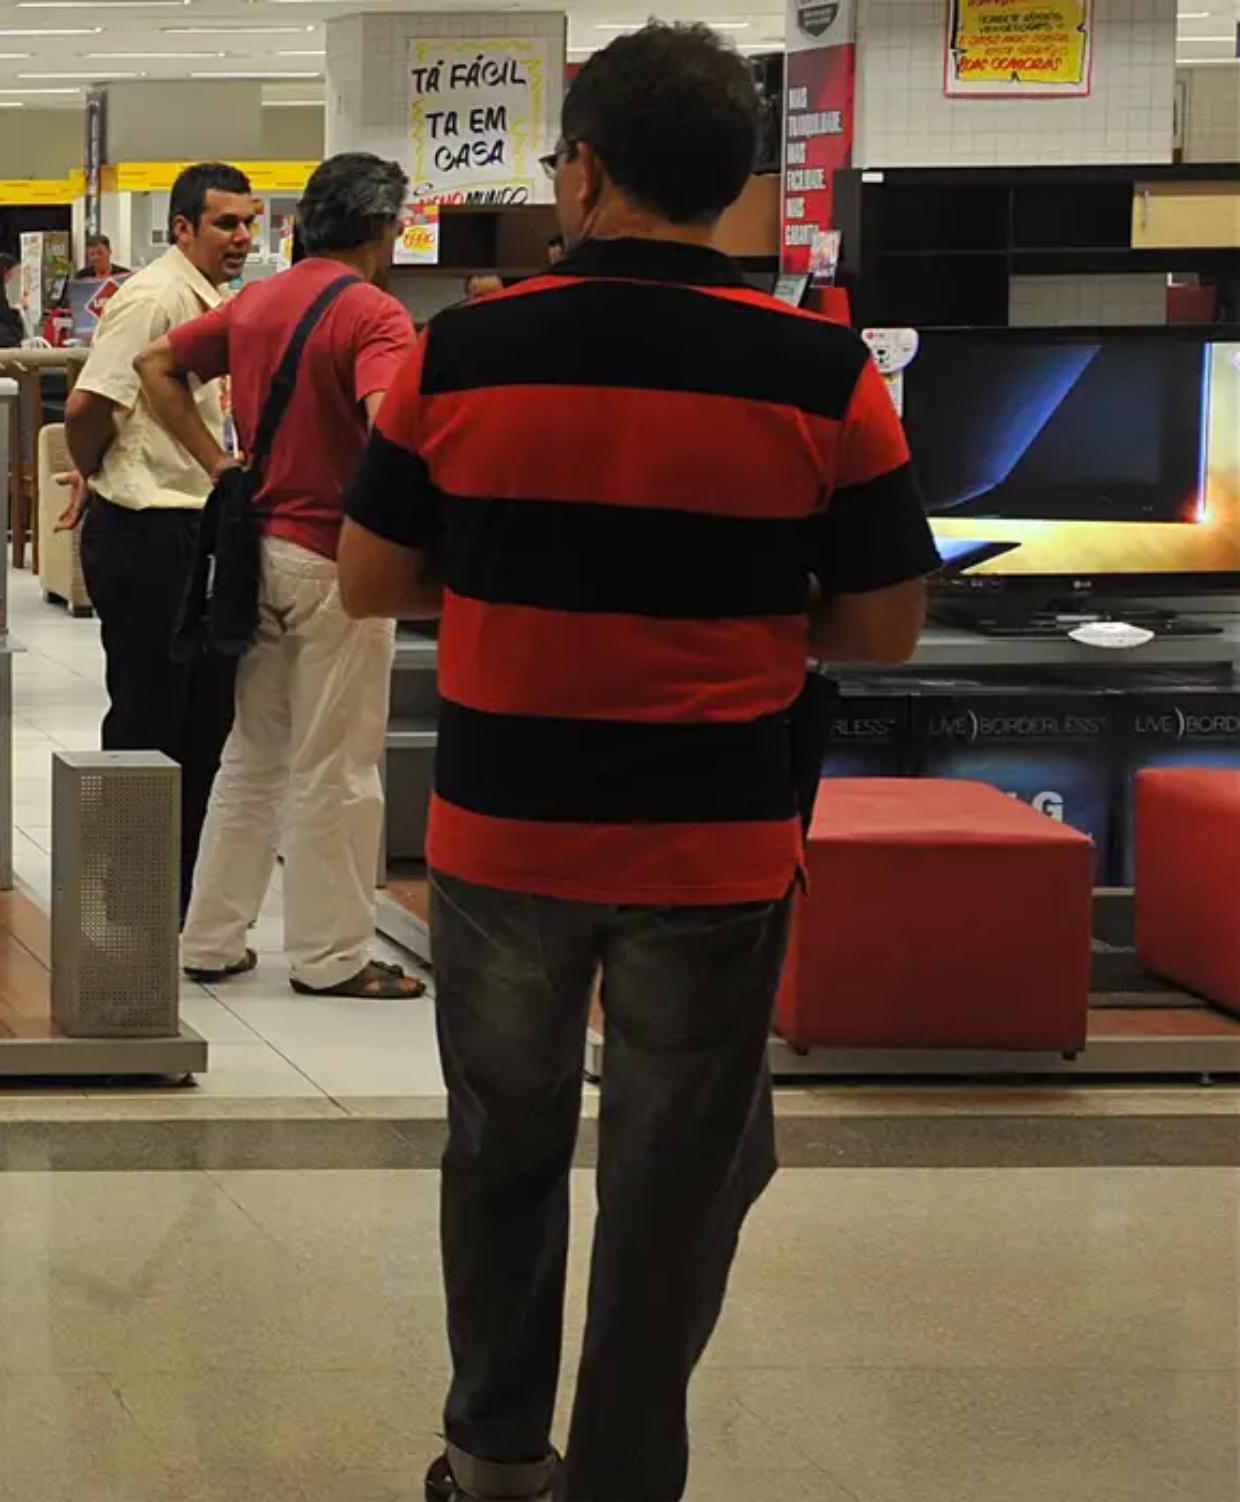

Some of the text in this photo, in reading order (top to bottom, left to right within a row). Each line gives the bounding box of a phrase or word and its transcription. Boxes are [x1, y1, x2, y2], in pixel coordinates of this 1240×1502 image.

[450, 54, 526, 89] FÁCIL
[469, 106, 507, 133] EM
[434, 140, 504, 172] CASA
[1135, 716, 1174, 733] LIVE
